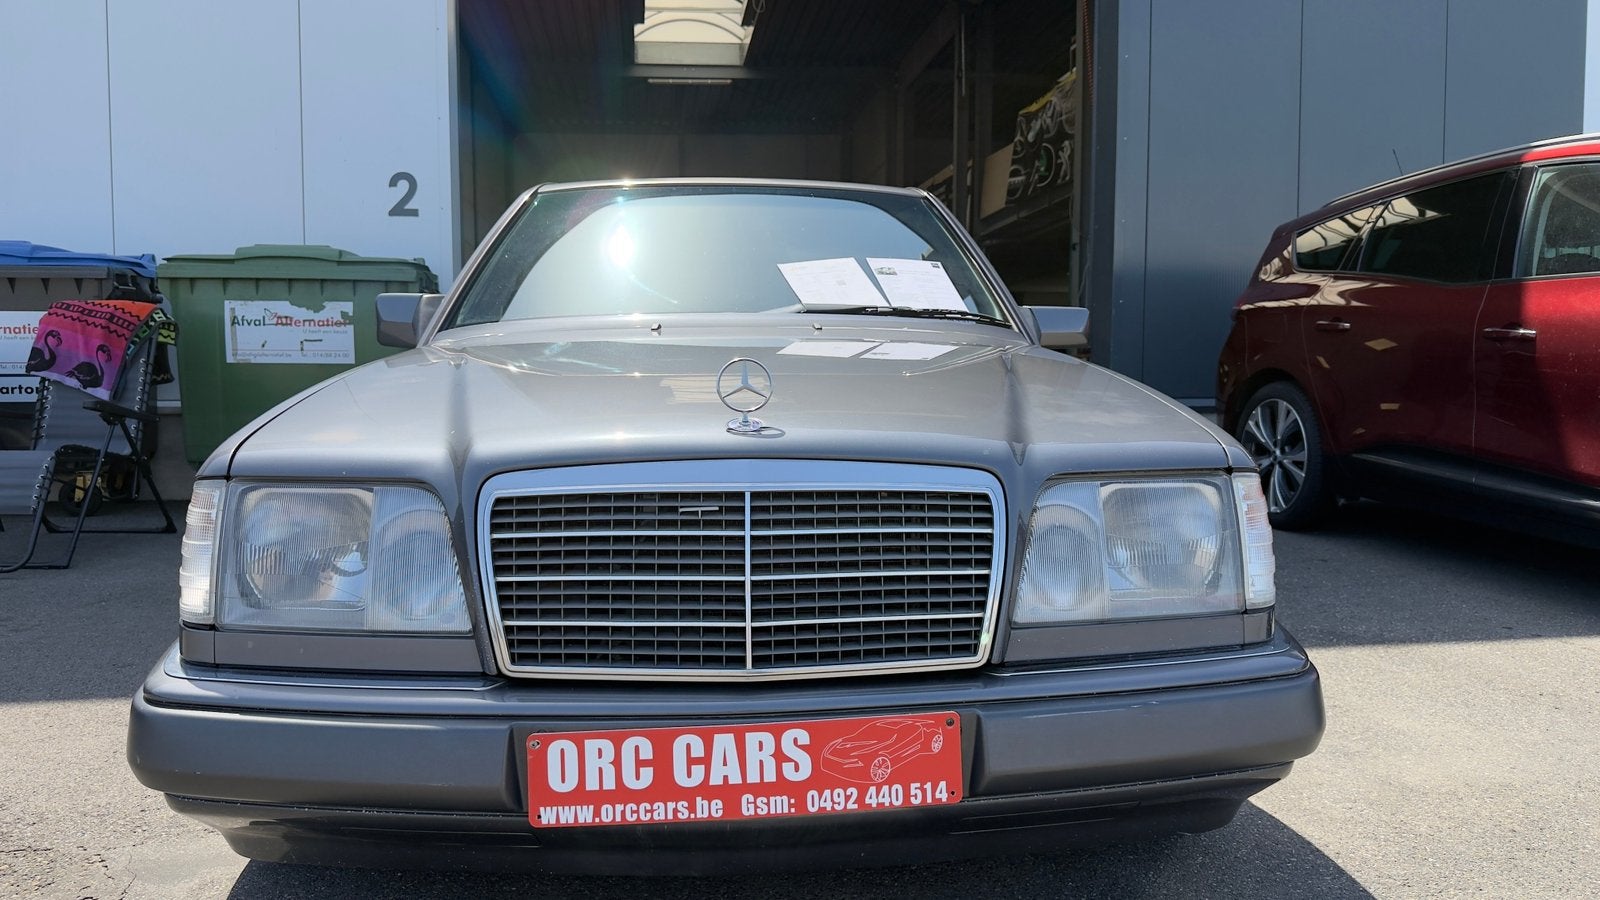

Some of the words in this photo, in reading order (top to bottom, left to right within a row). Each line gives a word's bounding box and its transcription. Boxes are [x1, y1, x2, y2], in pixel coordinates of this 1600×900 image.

[388, 172, 419, 217] 2
[231, 314, 266, 327] Afval
[275, 315, 348, 328] Alternatief
[547, 736, 654, 793] ORC
[673, 729, 812, 788] CARS
[540, 796, 723, 825] www.orccars.be
[741, 793, 795, 816] Gsm:
[806, 787, 858, 812] 0492
[865, 784, 903, 808] 440
[910, 780, 948, 803] 514
